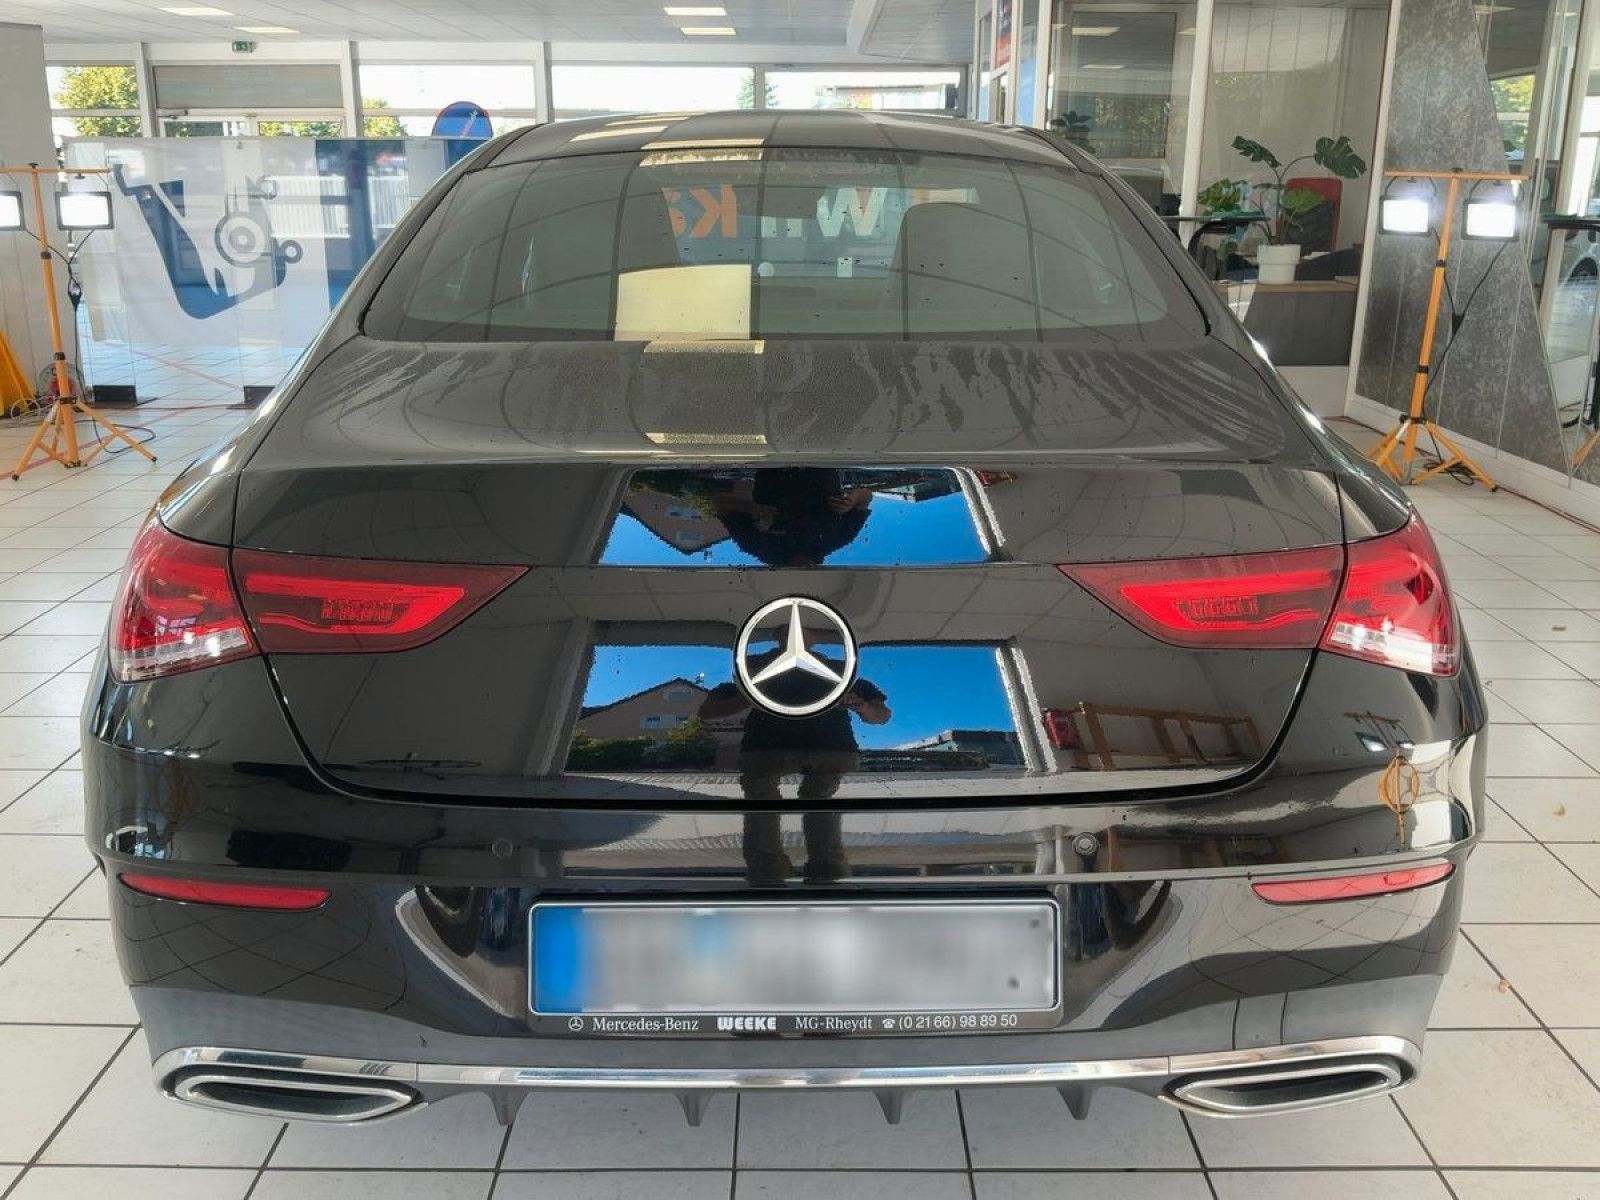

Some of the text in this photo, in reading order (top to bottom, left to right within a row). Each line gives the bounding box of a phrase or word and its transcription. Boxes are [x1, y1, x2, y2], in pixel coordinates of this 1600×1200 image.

[592, 1017, 699, 1031] Mercedes-Benz
[716, 1016, 777, 1031] WEEKE
[795, 1017, 873, 1032] MG-Rheydt
[959, 1014, 977, 1028] 98
[979, 1014, 997, 1028] 89
[1000, 1013, 1018, 1027] 50
